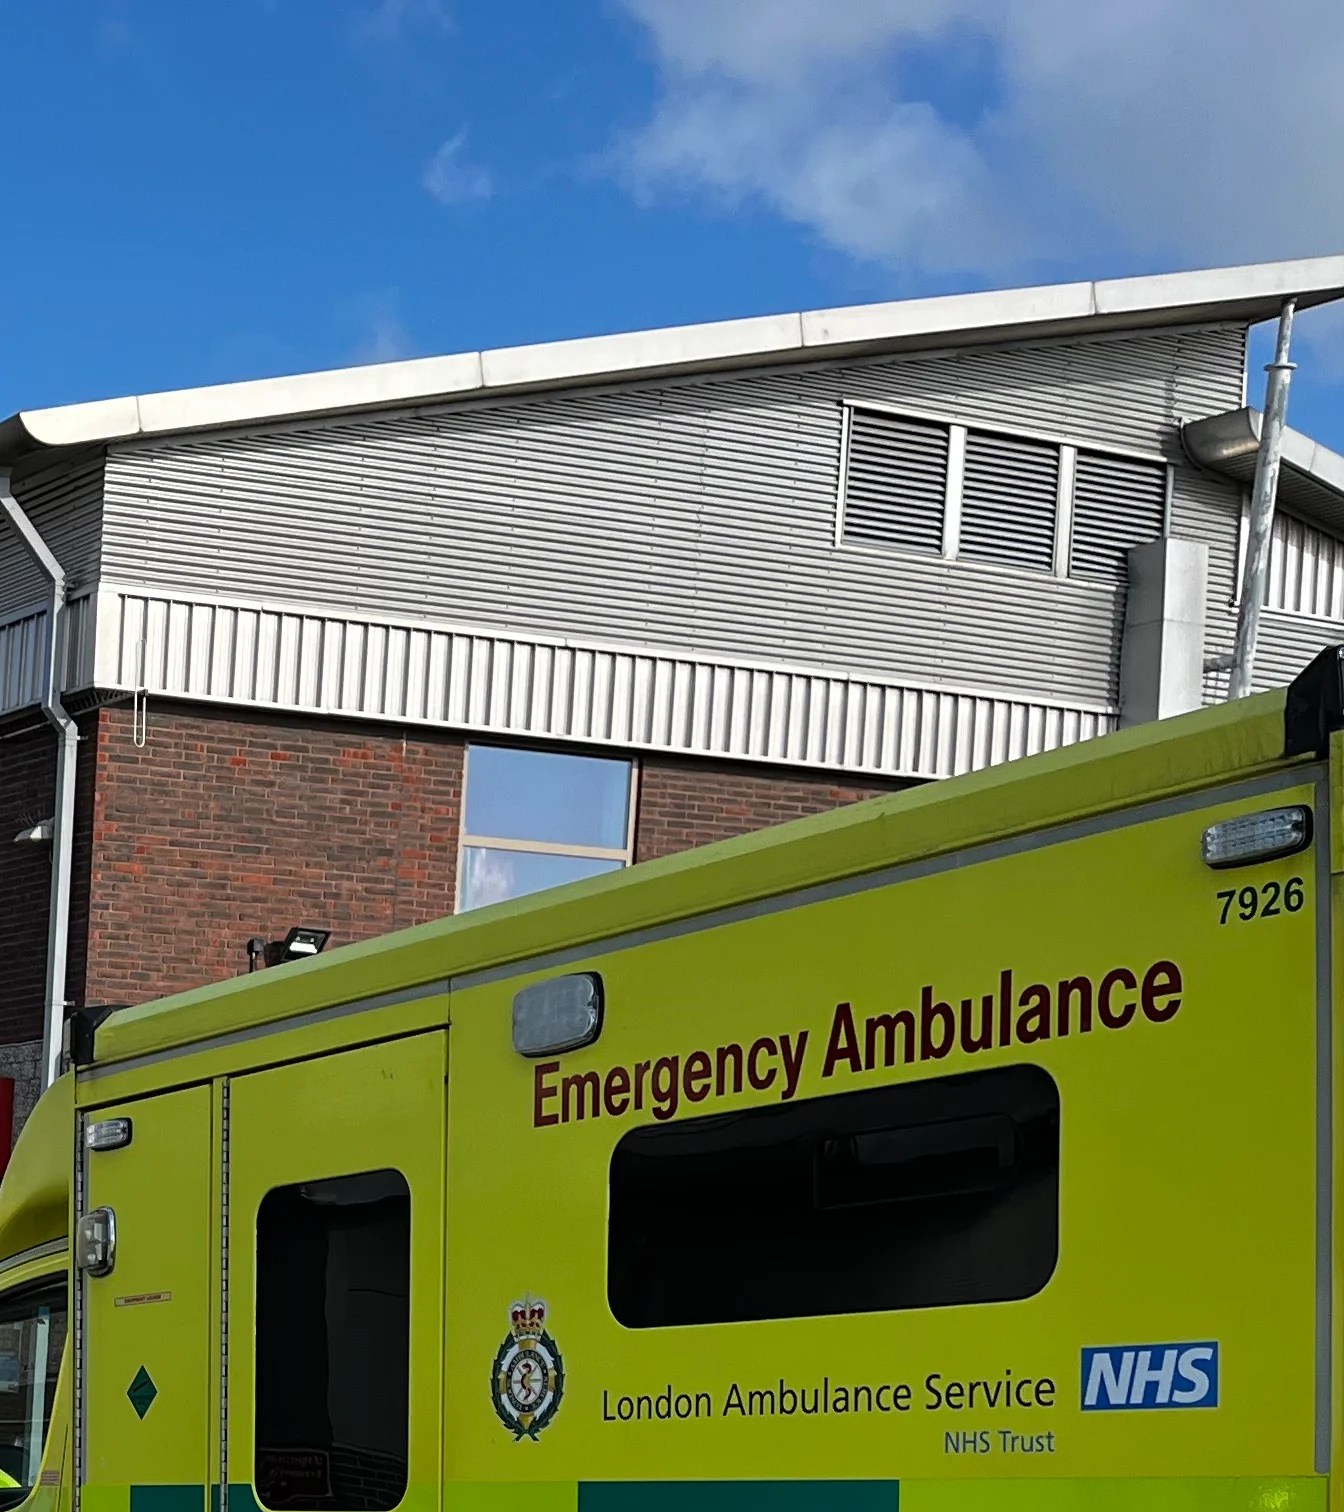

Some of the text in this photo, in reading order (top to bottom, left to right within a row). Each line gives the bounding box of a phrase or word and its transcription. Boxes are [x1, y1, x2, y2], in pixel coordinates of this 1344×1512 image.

[1216, 876, 1304, 925] 7926
[532, 960, 1183, 1129] Emergency Ambulance
[603, 1369, 1056, 1421] London Ambulance Service
[1083, 1347, 1214, 1406] NHS
[944, 1430, 1055, 1454] NHS Trust
